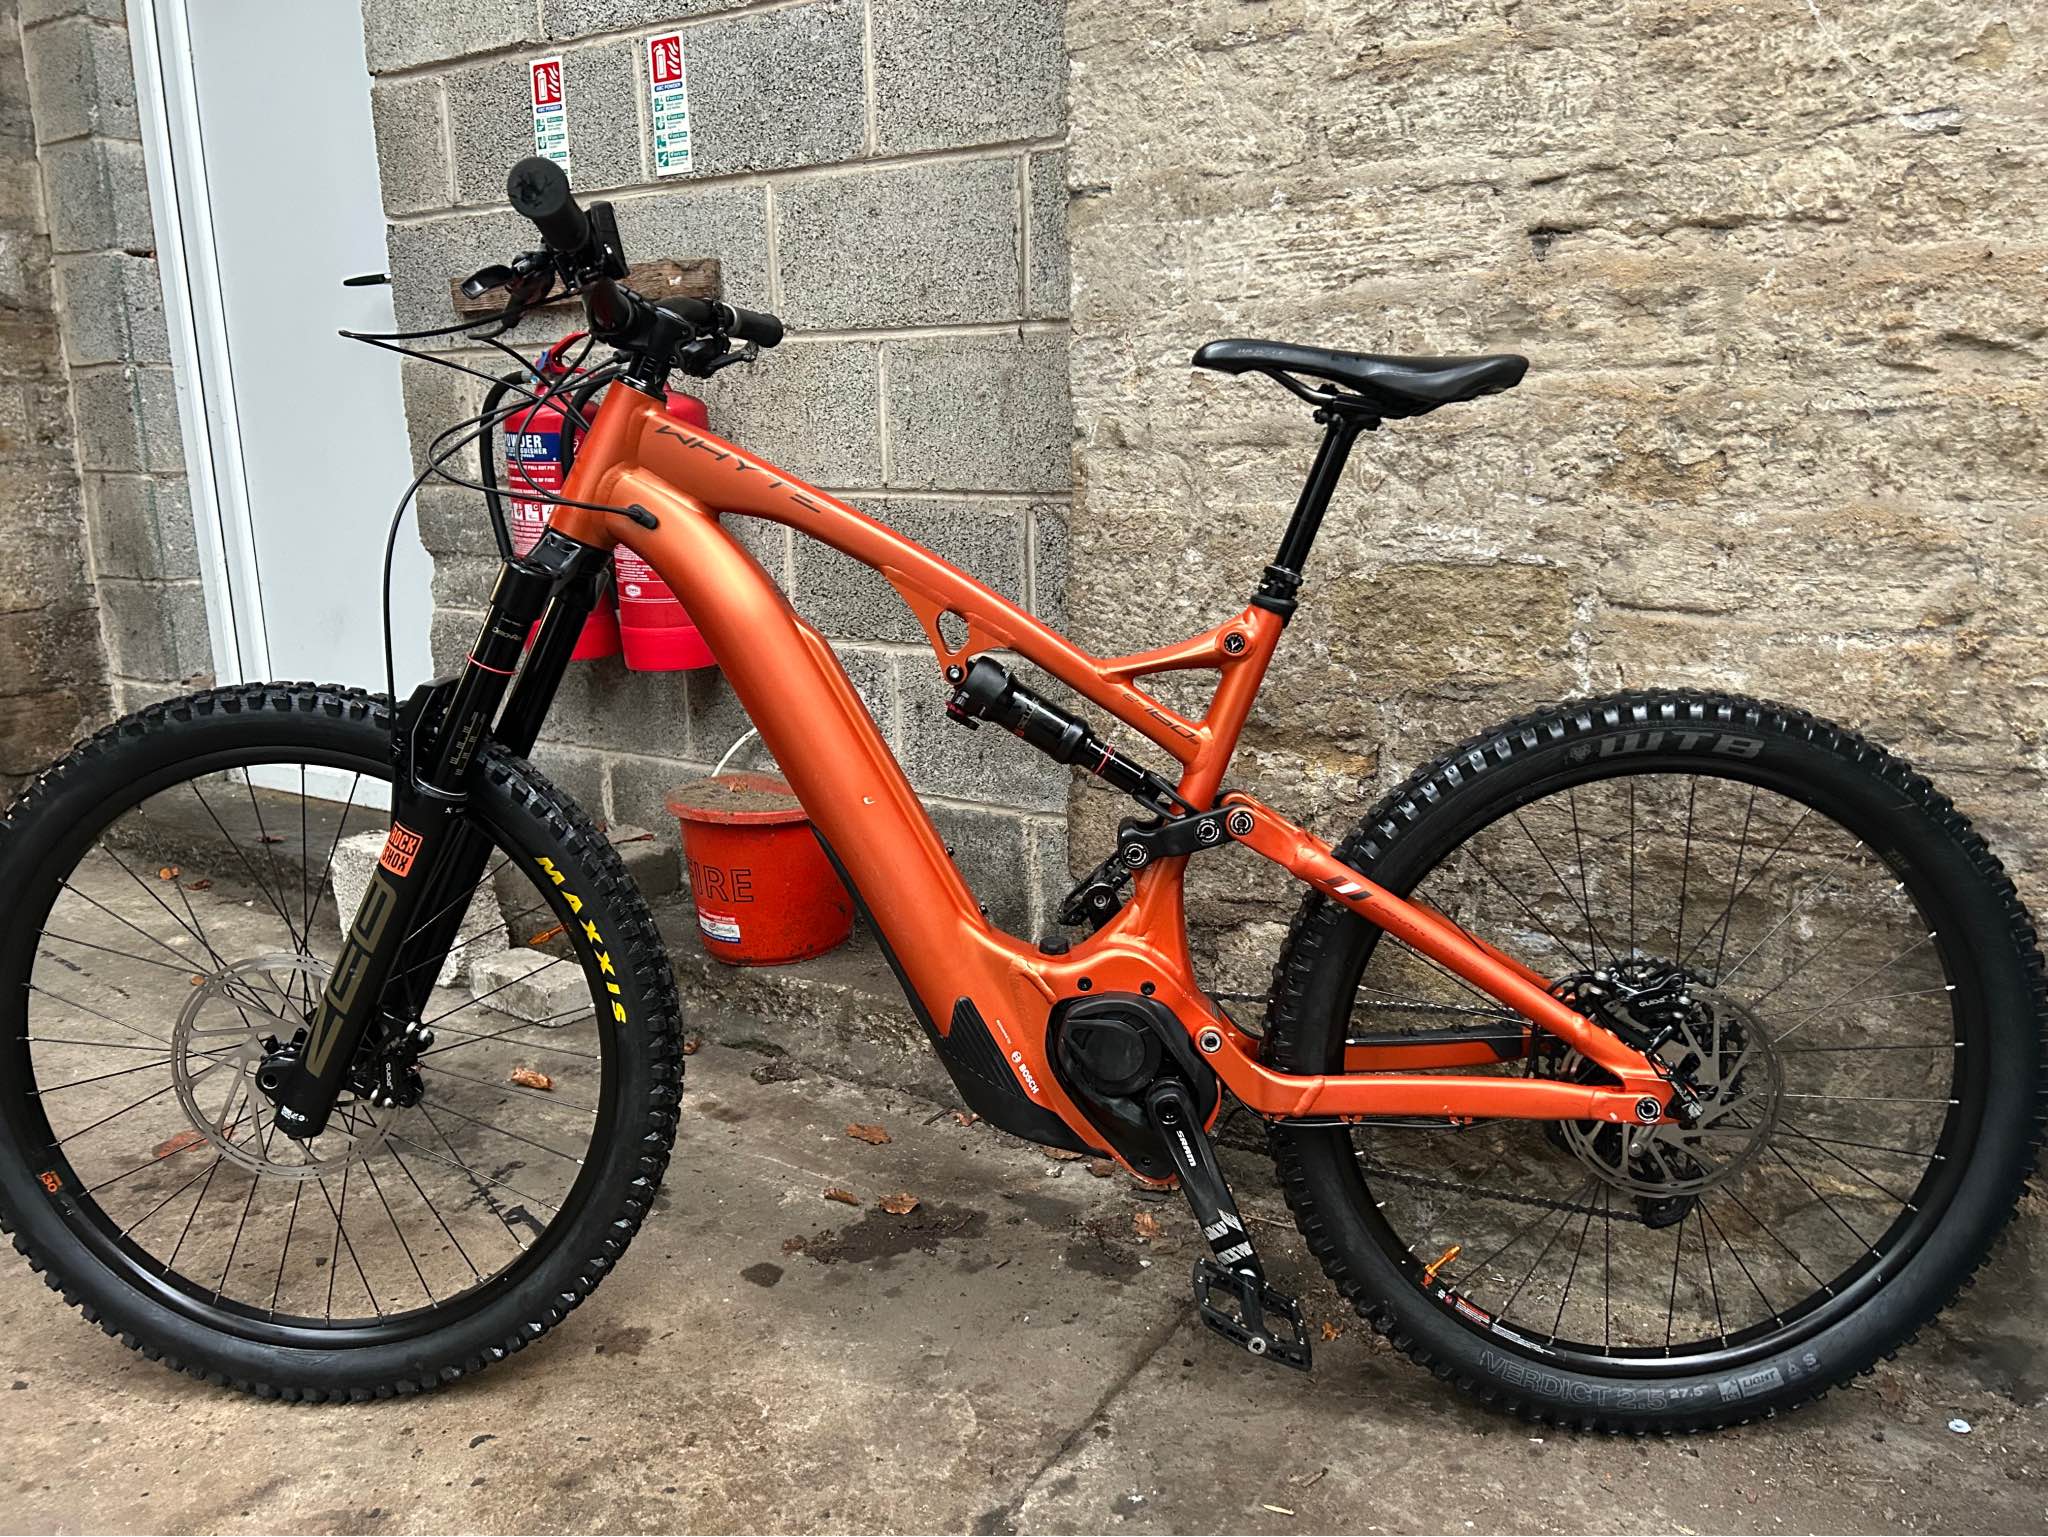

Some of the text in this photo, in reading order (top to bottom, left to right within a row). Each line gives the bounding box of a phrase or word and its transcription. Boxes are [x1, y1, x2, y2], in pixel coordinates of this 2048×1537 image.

[655, 425, 831, 514] WHYTE
[1599, 731, 1765, 760] WTB
[391, 826, 418, 855] ROCK
[381, 844, 409, 873] SHOX
[535, 856, 627, 1025] MAXXIS
[1019, 1063, 1039, 1094] BOSCH
[1176, 1130, 1197, 1168] SRAM
[1485, 1351, 1611, 1407] VERDICT
[1616, 1385, 1668, 1411] 2.5
[1743, 1370, 1776, 1389] LIGHT
